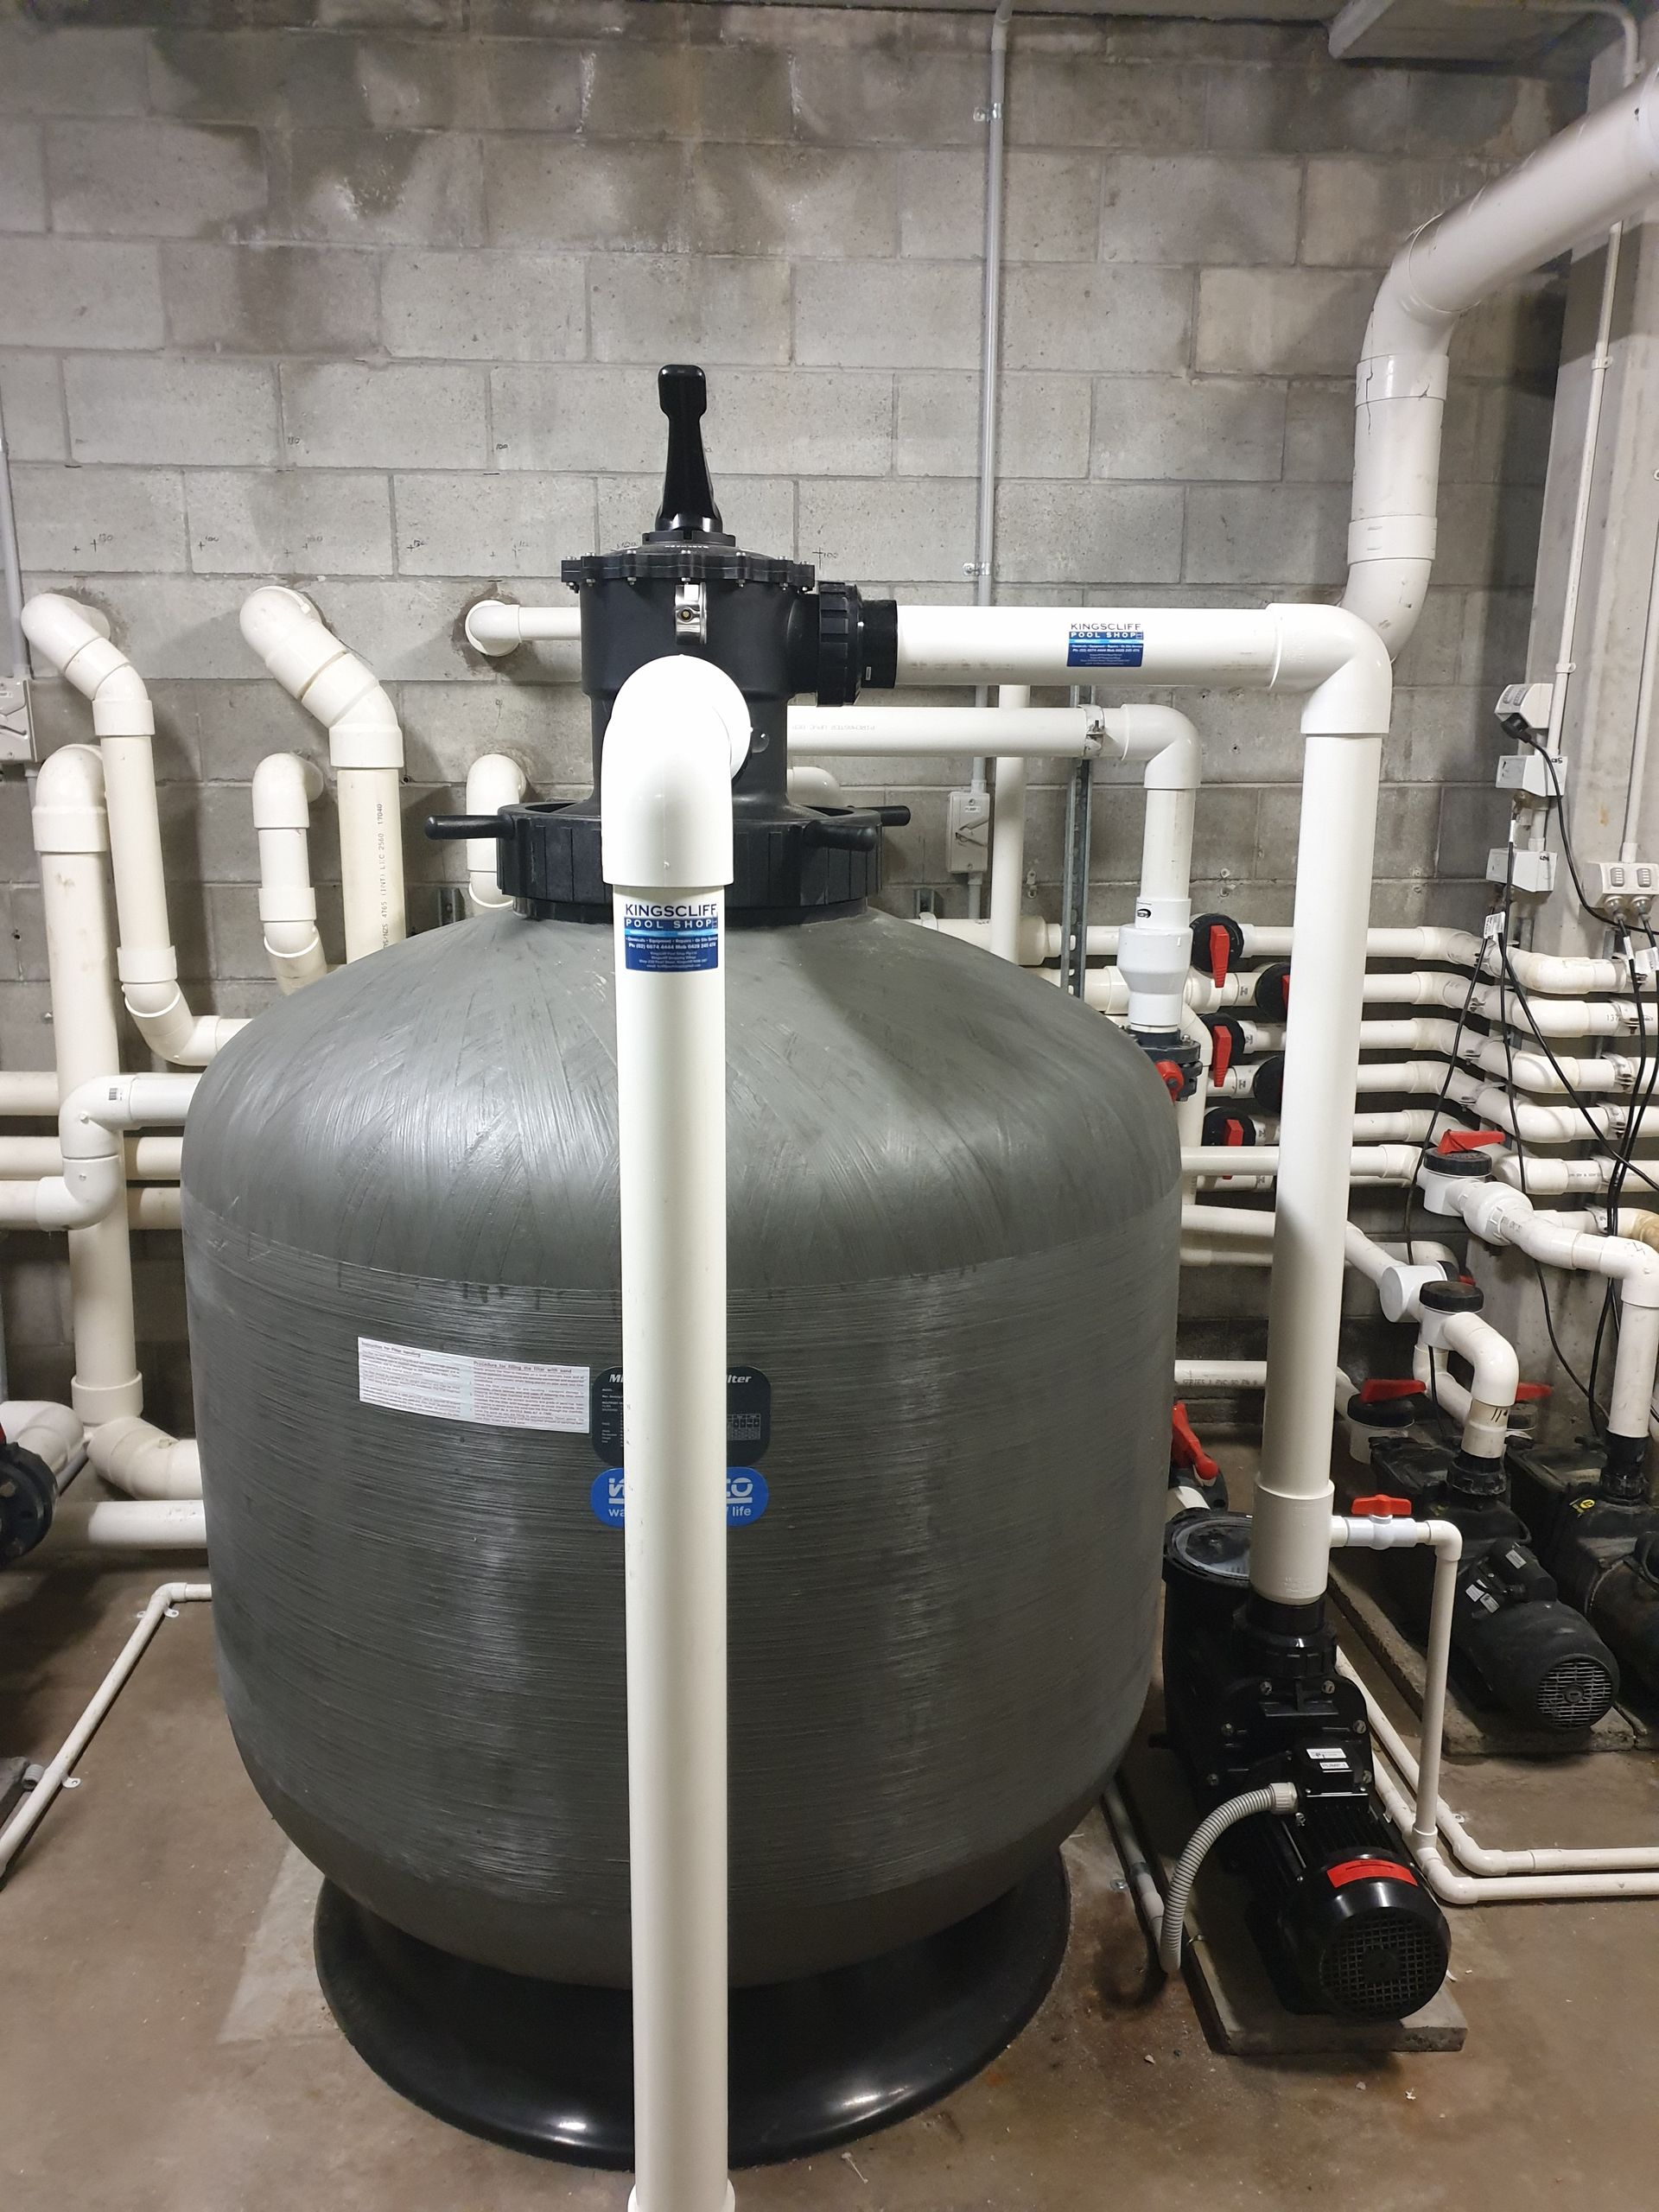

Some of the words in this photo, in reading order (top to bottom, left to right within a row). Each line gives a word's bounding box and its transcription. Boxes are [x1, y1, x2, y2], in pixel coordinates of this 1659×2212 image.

[625, 903, 717, 918] KINGSCLIFF
[626, 918, 664, 929] POOL
[673, 918, 712, 929] SHOP
[727, 1374, 752, 1383] lter
[732, 1505, 752, 1517] life
